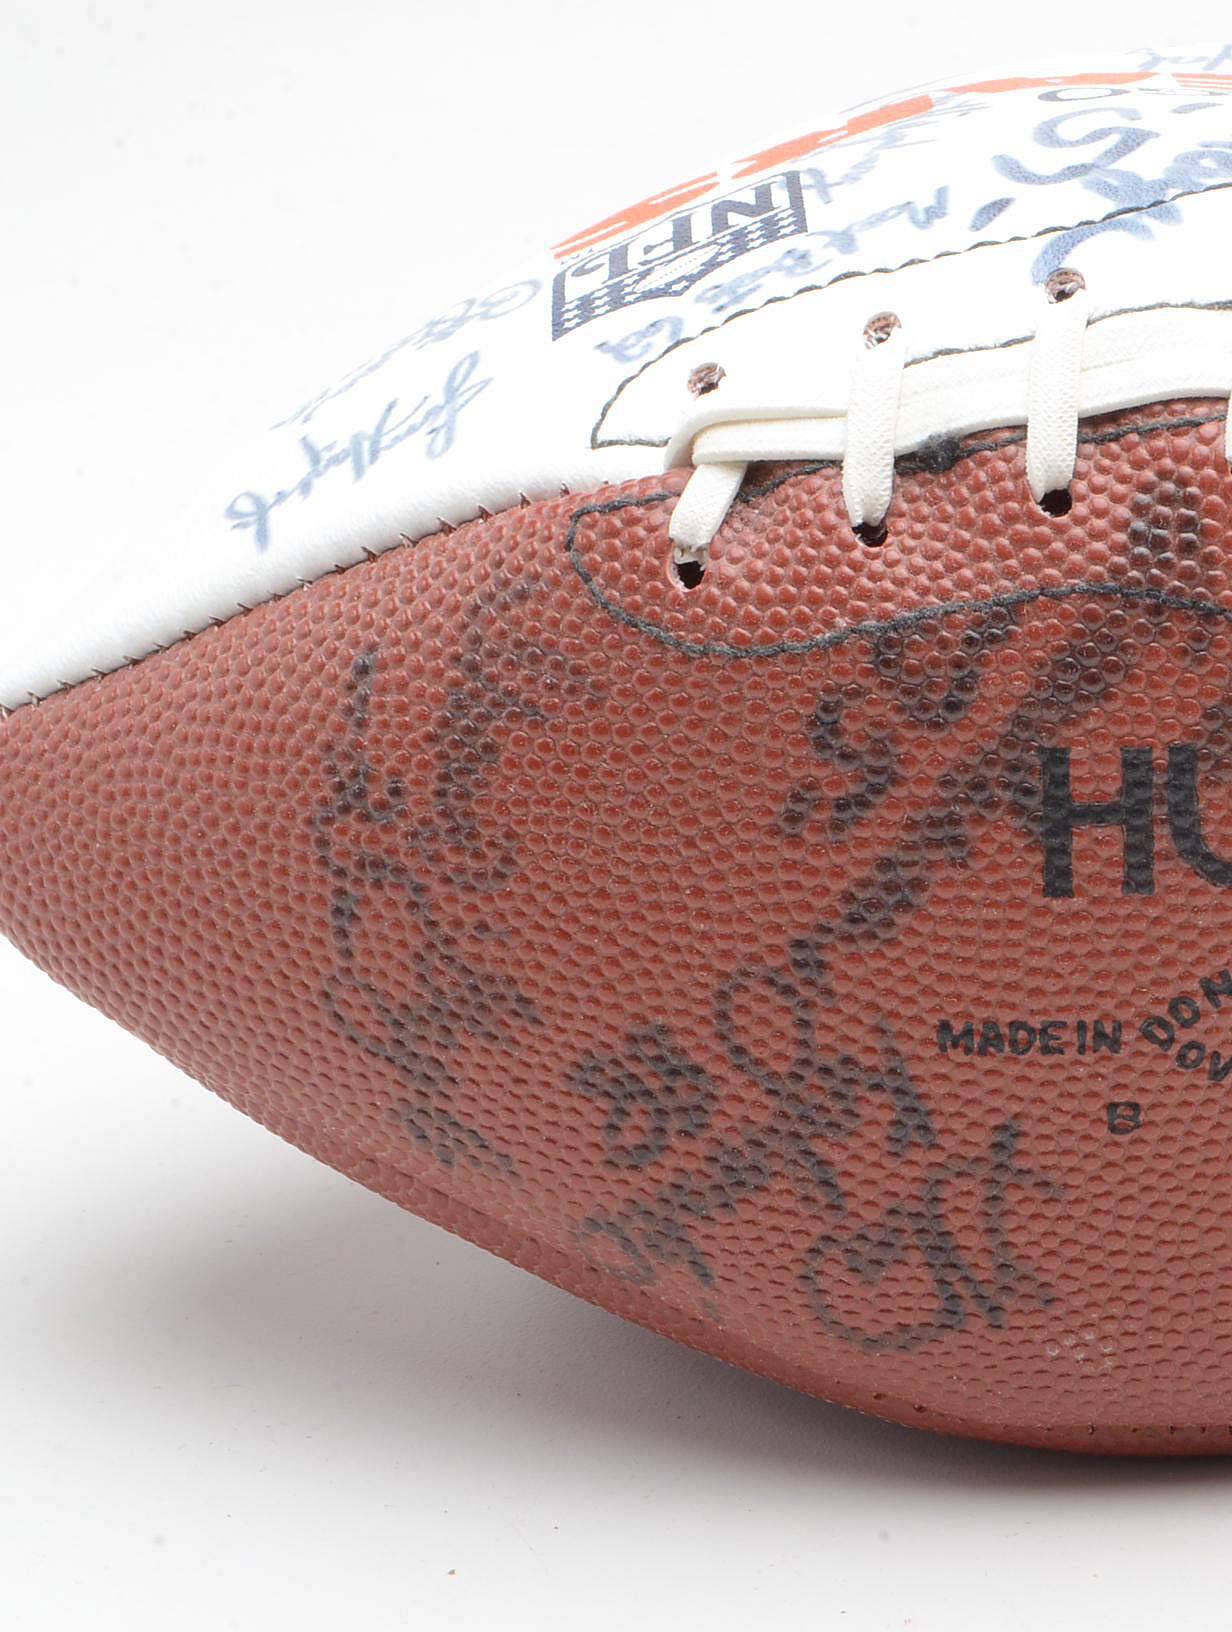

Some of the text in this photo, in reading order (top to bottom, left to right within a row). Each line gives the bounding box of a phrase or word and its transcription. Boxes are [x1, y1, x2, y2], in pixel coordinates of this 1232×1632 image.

[569, 181, 781, 286] NFL
[937, 1018, 1067, 1056] MADE
[1077, 1019, 1122, 1055] IN
[1139, 996, 1201, 1051] DO
